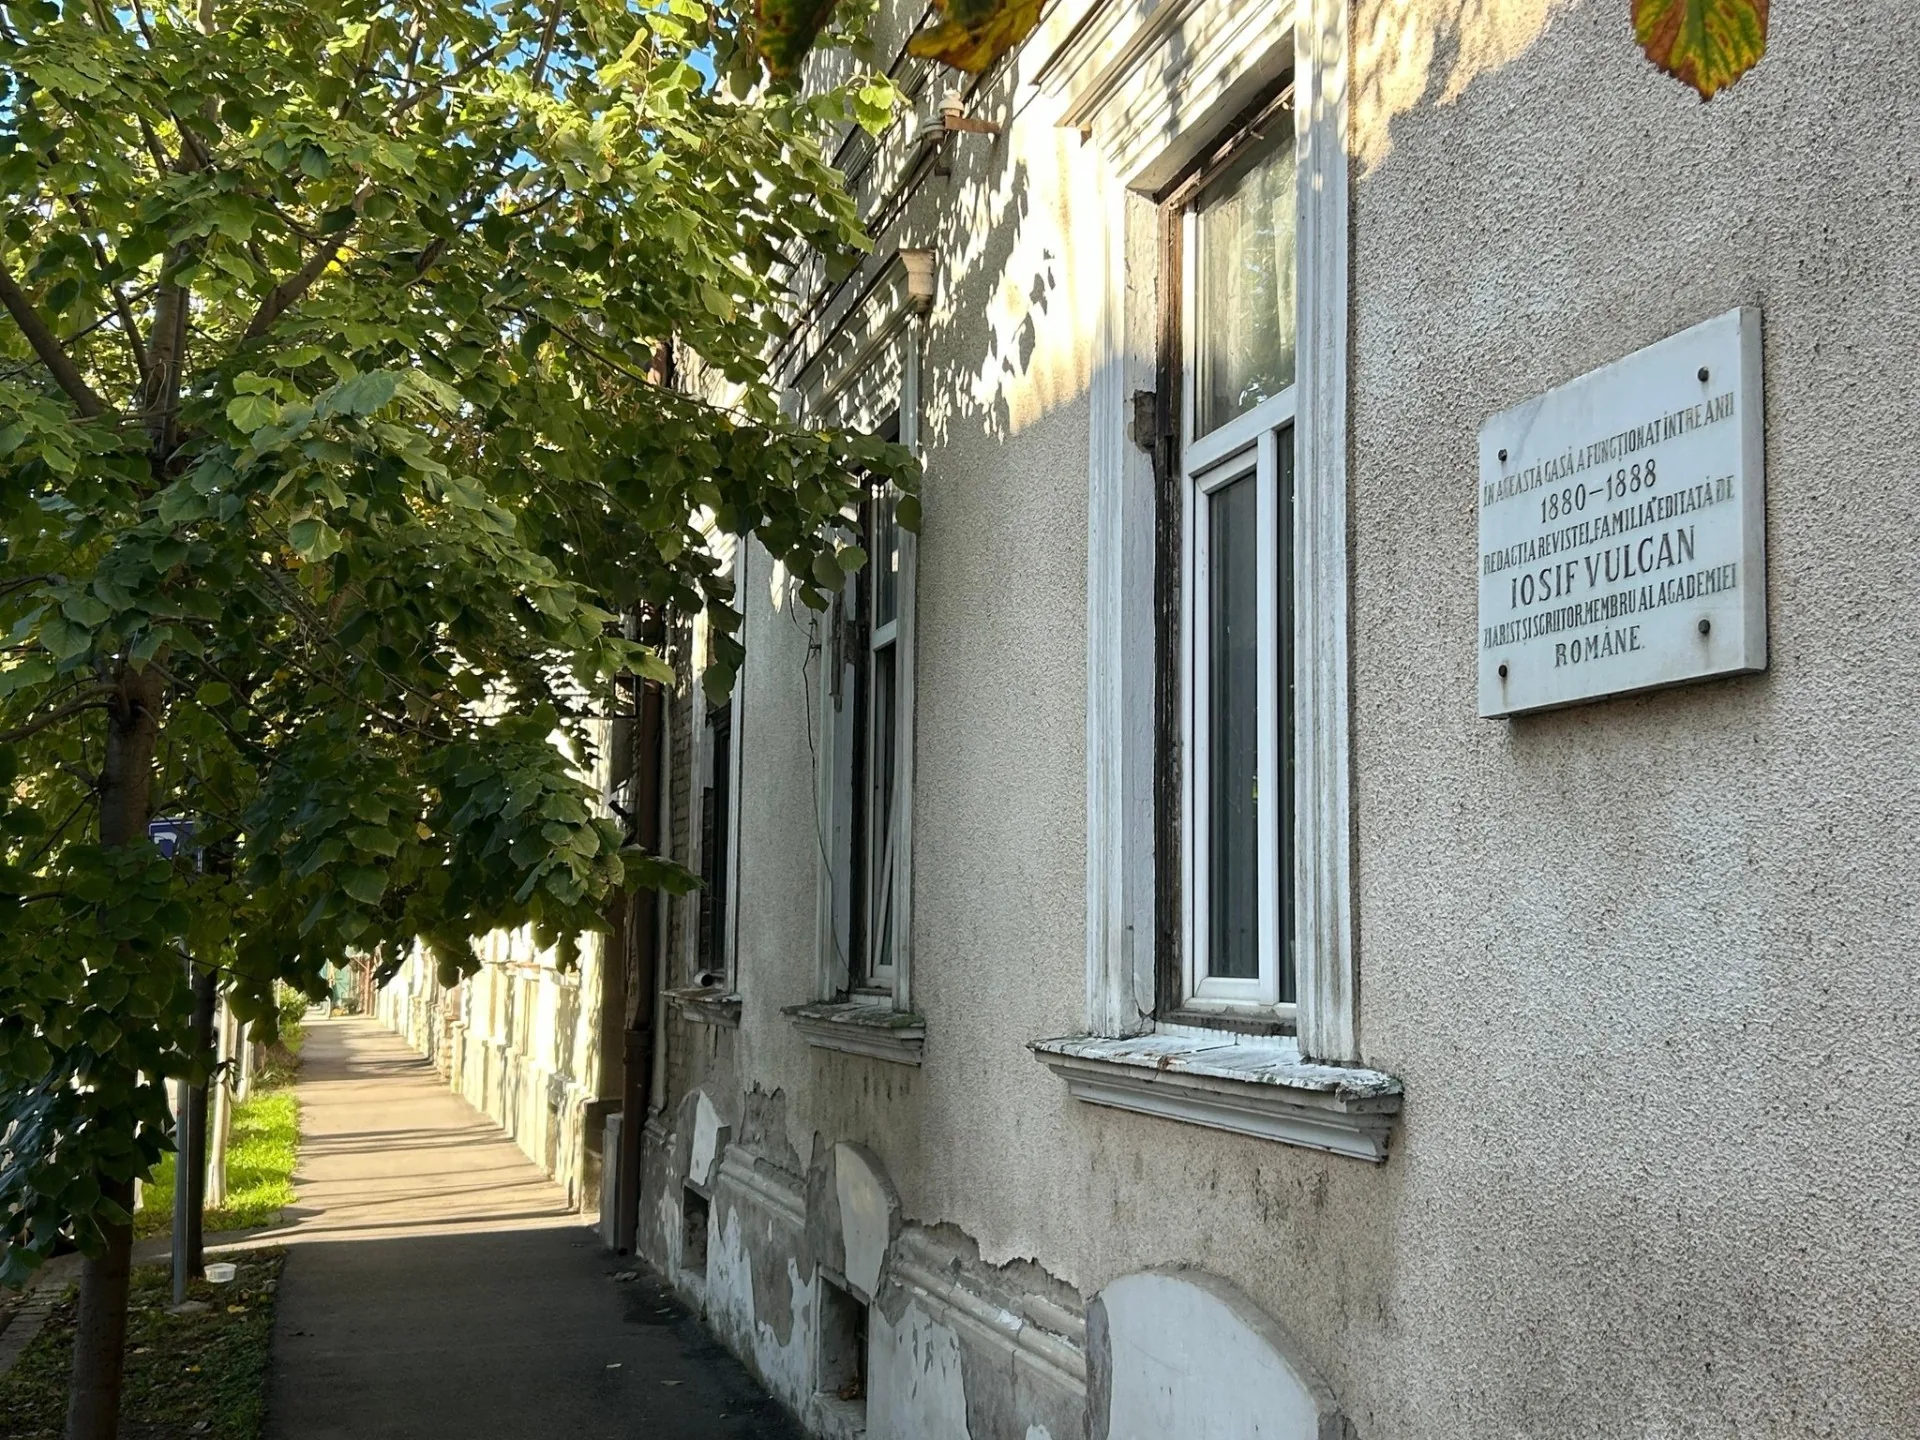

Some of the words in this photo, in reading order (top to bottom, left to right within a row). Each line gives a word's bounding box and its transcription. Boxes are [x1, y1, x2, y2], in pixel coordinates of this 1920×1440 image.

[1576, 448, 1586, 473] A
[1704, 391, 1734, 426] ANII
[1537, 521, 1590, 559] REVISTEI
[1715, 474, 1736, 504] DE
[1484, 619, 1521, 649] ZIARIST
[1583, 588, 1636, 627] MEMBRU
[1638, 584, 1656, 613] AL
[1656, 562, 1738, 608] ACADEMIEI
[1511, 559, 1579, 610] IOSIF
[1584, 524, 1696, 589] VULCAN
